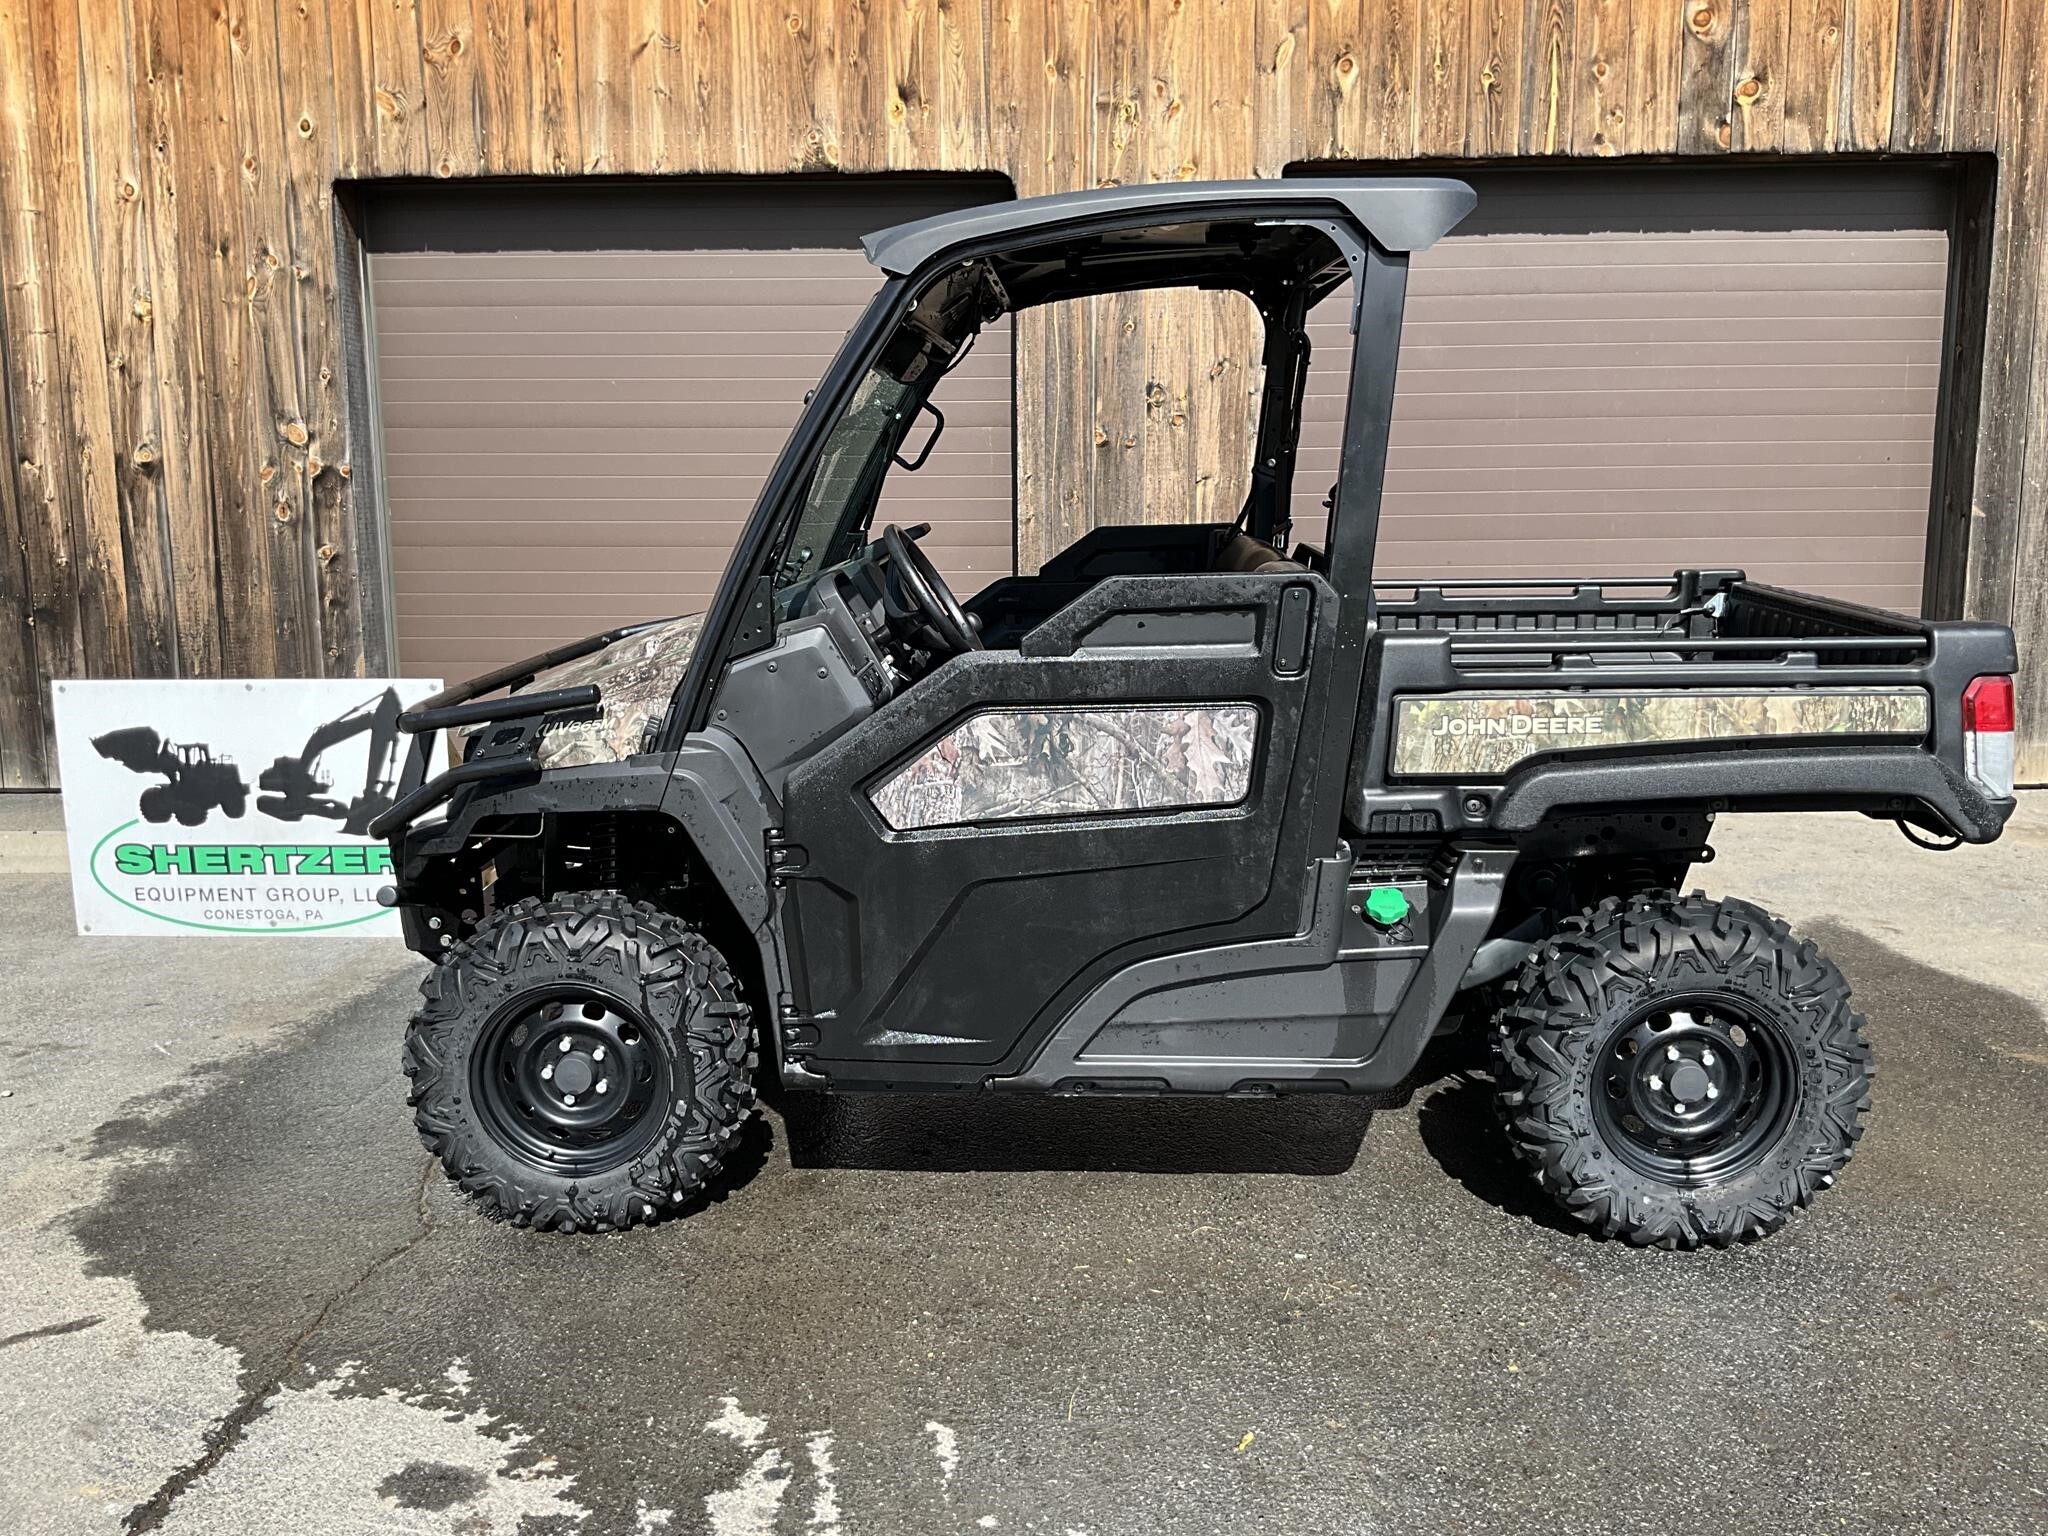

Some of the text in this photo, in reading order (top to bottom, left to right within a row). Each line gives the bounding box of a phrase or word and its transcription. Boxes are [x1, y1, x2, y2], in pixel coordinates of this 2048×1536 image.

[1432, 714, 1602, 736] JOHN DEERE
[115, 843, 395, 875] SHERTZER
[134, 887, 379, 905] EQUIPMENT GROUP, LL
[203, 909, 324, 922] CONESTOGA, PA
